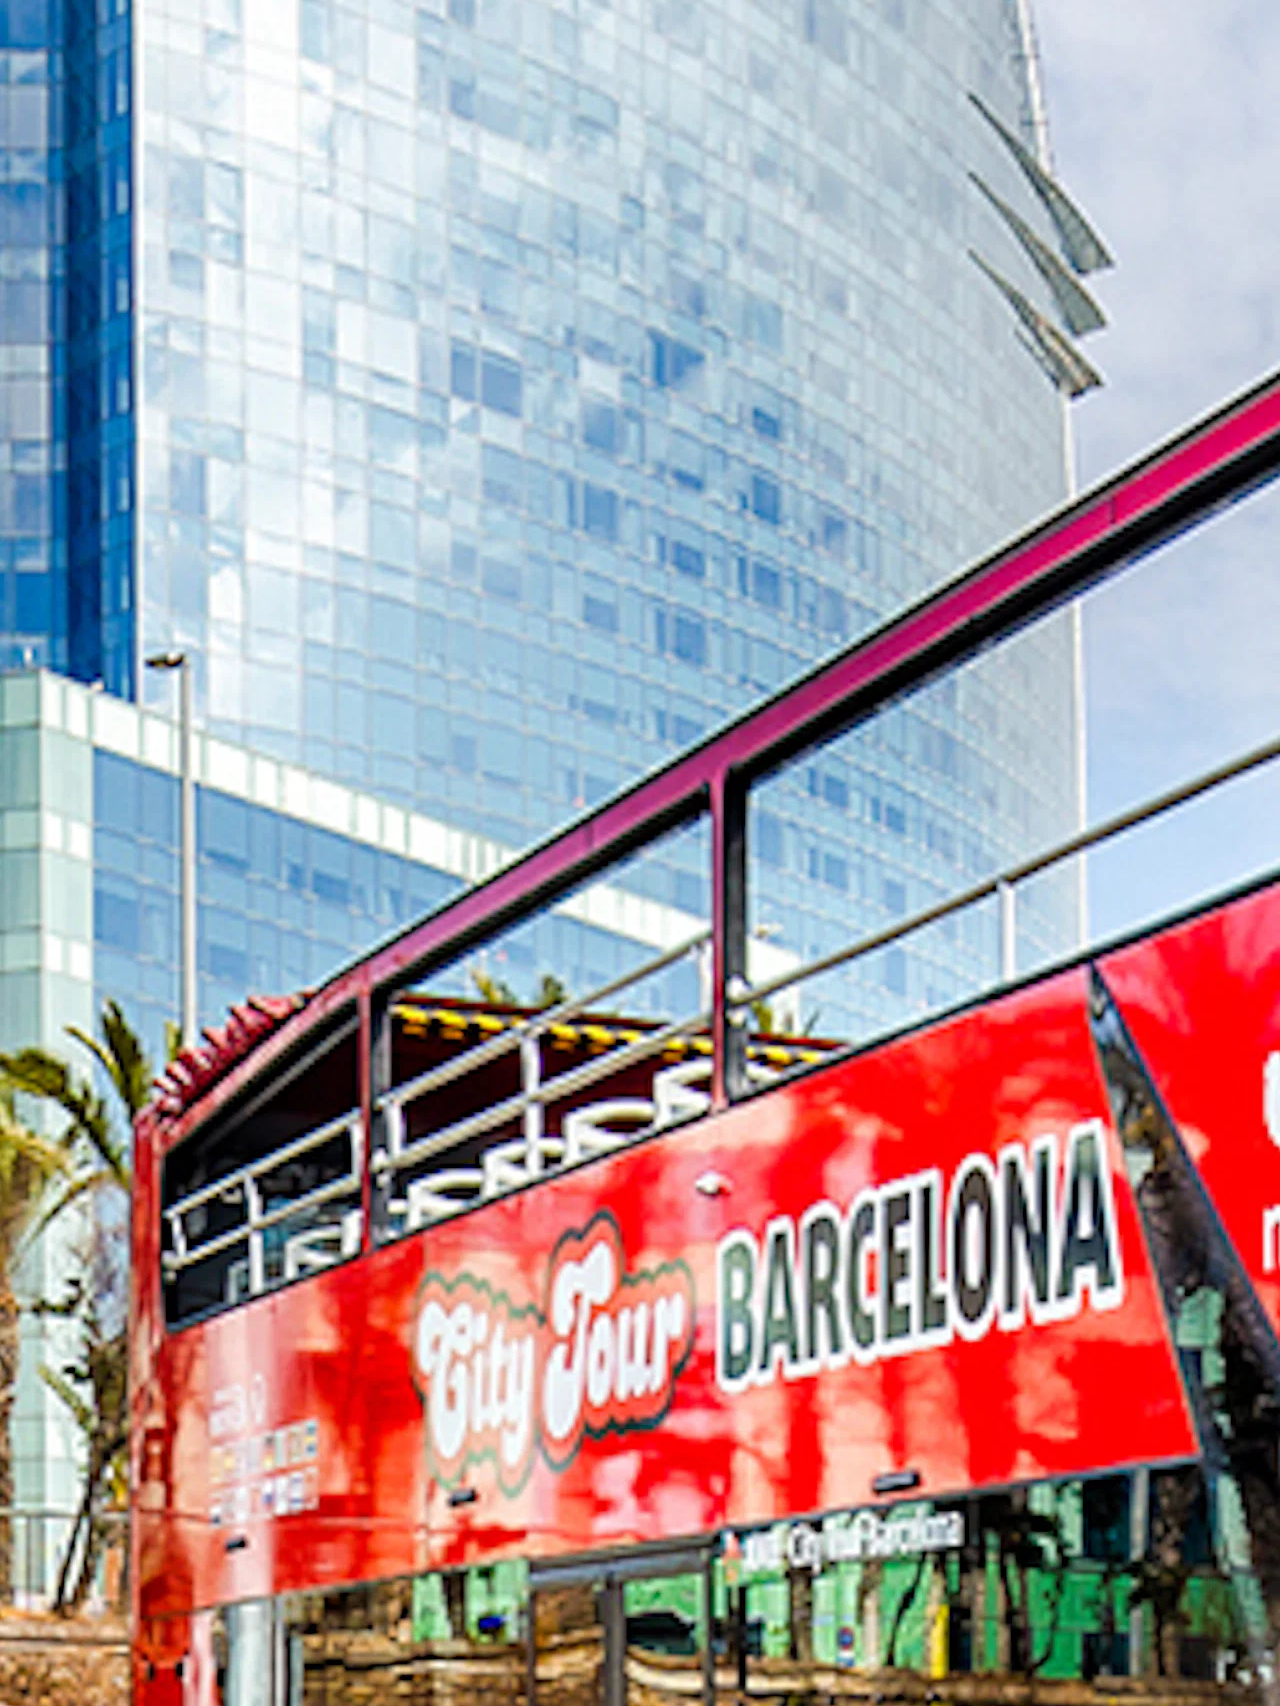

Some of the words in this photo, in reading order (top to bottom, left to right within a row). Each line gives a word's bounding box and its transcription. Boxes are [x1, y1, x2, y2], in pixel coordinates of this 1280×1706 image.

[417, 1299, 535, 1467] City
[542, 1240, 685, 1441] Tour
[718, 1125, 1119, 1383] BARCELONA
